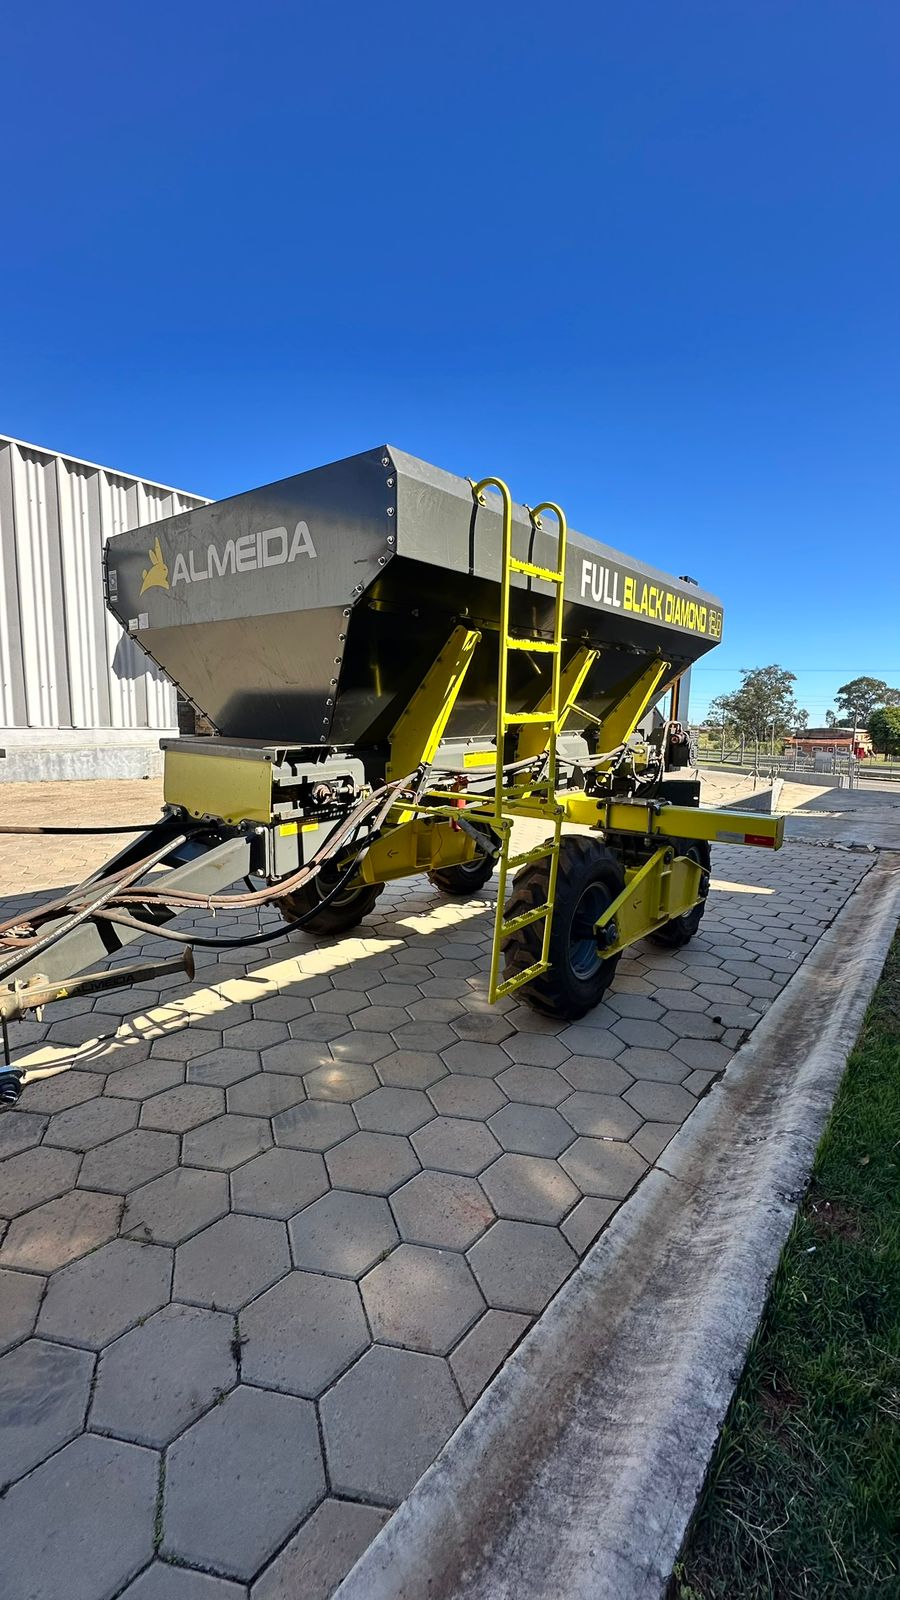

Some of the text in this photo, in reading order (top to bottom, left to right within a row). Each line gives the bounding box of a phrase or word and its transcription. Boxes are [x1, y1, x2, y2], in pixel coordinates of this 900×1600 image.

[172, 520, 318, 587] ALMEIDA
[581, 560, 621, 608] FULL
[623, 576, 665, 621] BLACK
[665, 593, 707, 633] DIAMOND
